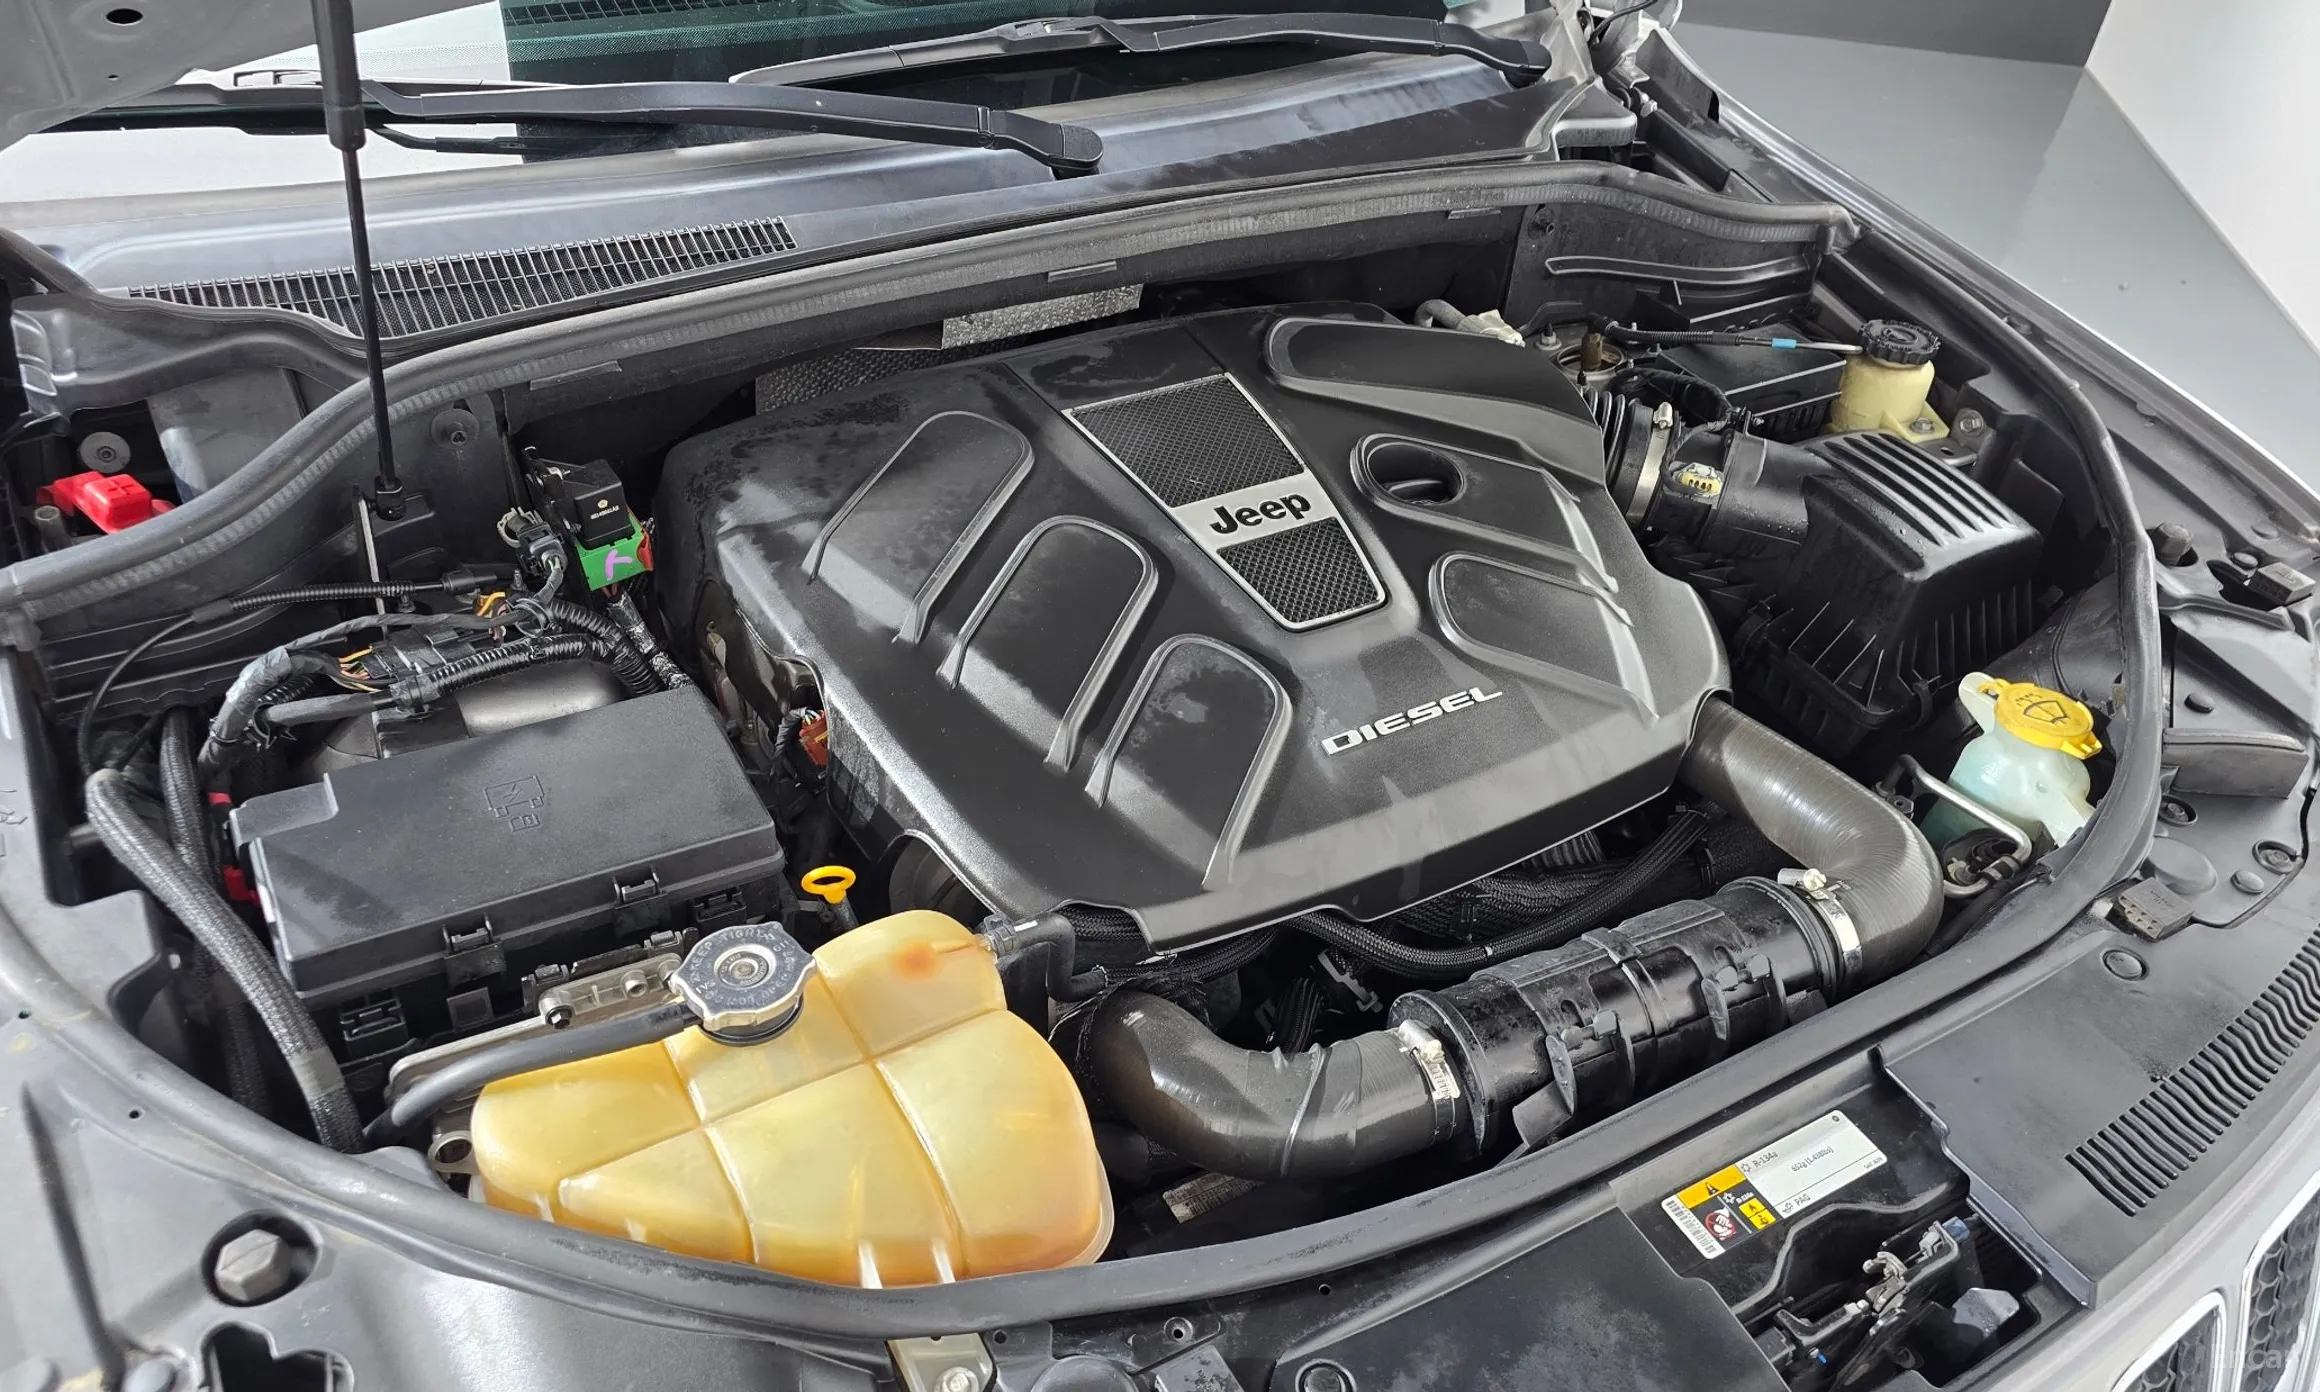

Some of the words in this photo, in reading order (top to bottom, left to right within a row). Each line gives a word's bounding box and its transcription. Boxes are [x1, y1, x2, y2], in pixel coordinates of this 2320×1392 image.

[1209, 494, 1312, 534] Jeep
[1321, 687, 1503, 757] DIESEL
[1752, 1151, 1779, 1168] R-134a
[1793, 1194, 1811, 1206] PAG
